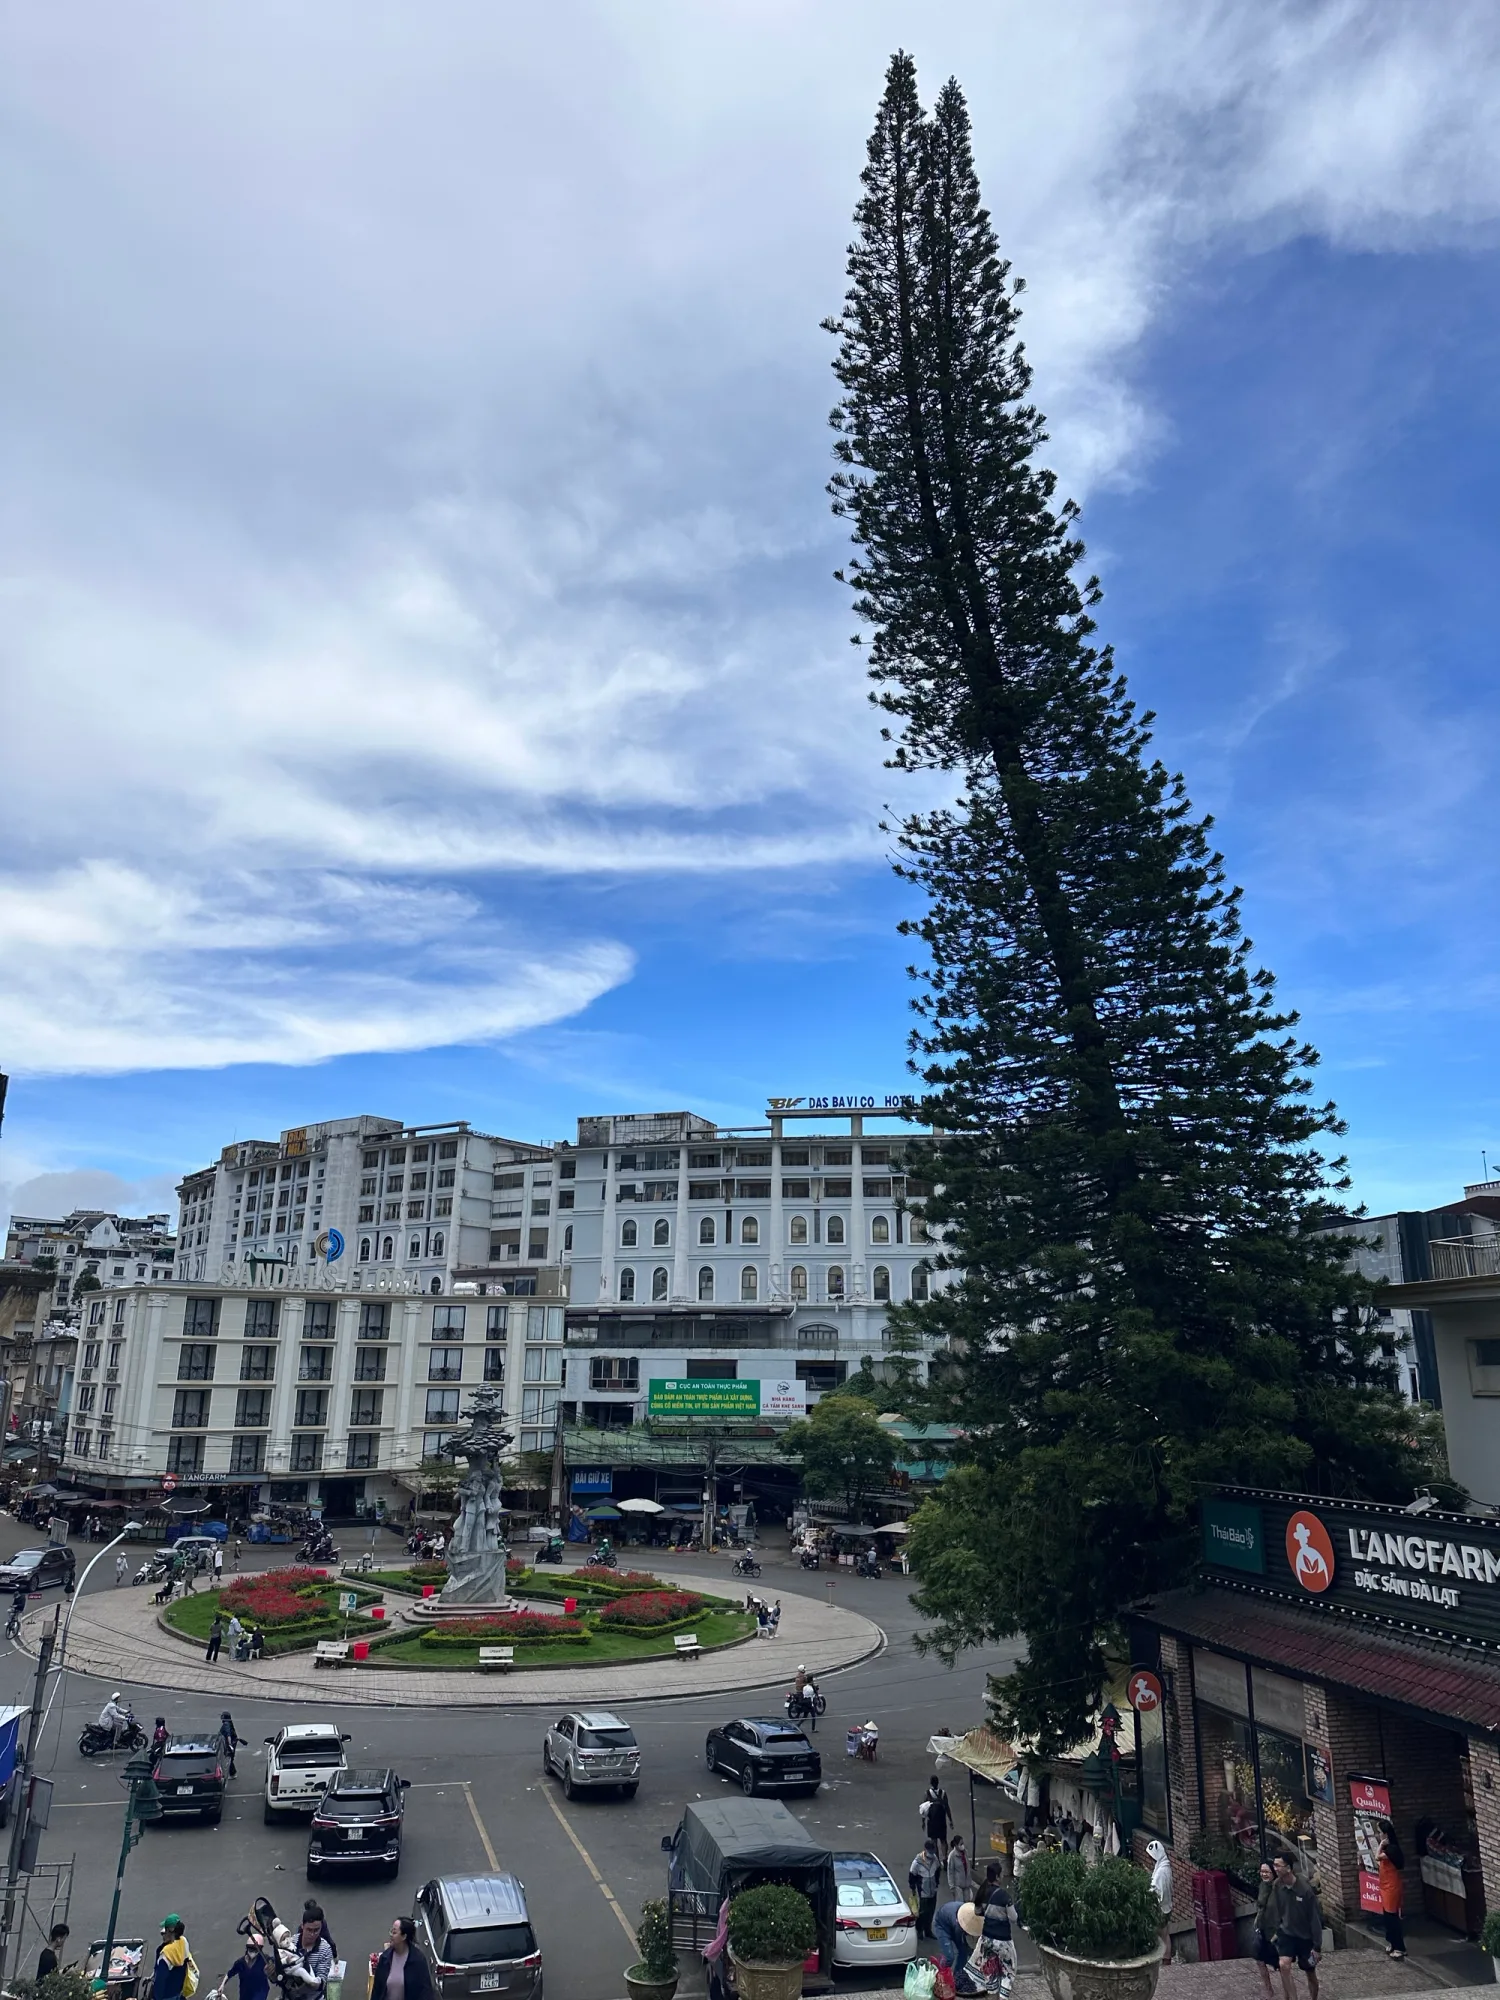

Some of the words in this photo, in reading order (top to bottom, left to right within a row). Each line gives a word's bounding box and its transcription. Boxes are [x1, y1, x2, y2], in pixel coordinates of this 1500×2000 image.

[220, 1261, 338, 1291] SANDALS
[347, 1267, 423, 1295] FLORA
[183, 1473, 227, 1481] L'ANGFARM
[575, 1470, 587, 1484] BÃI
[588, 1470, 600, 1484] GIỮ
[600, 1472, 610, 1484] XE
[1354, 1567, 1381, 1593] ĐẶC
[1381, 1571, 1410, 1597] SẢN
[1410, 1578, 1433, 1602] ĐÀ
[1432, 1585, 1461, 1610] LẠT
[1355, 1796, 1387, 1811] Quality
[1355, 1809, 1391, 1821] specialties
